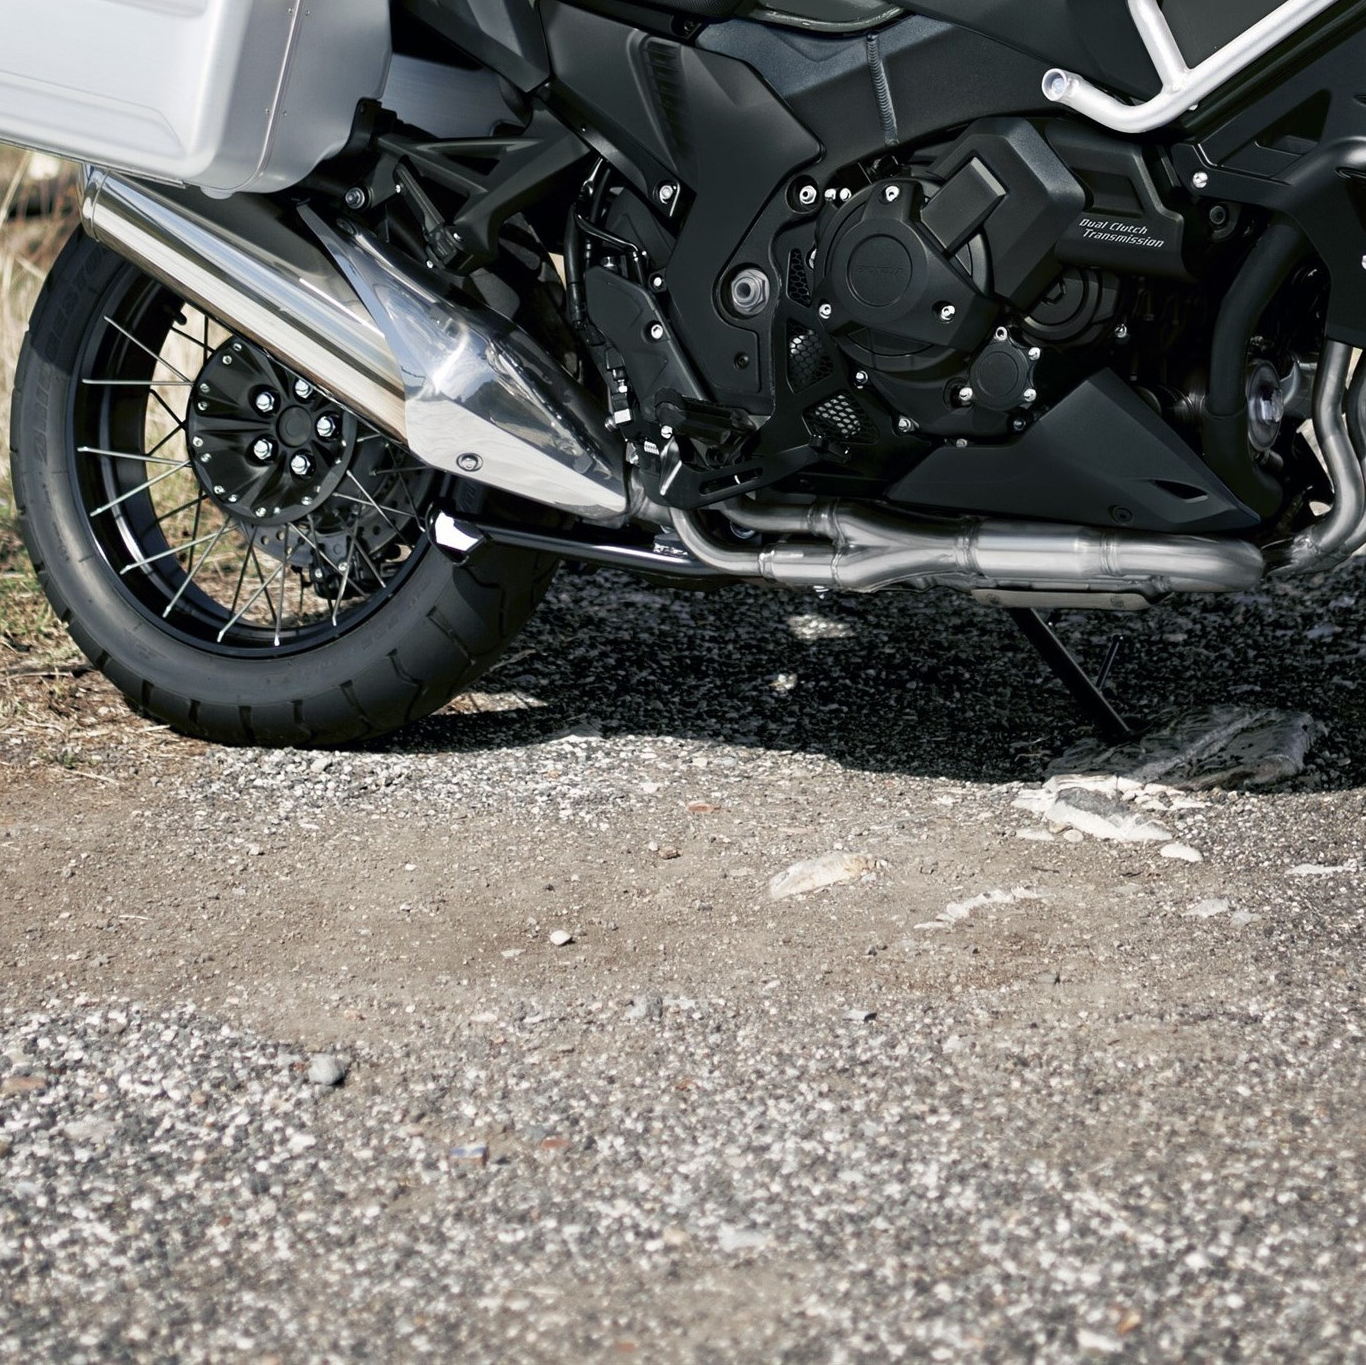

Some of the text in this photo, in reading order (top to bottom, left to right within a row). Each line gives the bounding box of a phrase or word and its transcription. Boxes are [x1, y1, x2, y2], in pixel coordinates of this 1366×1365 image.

[1078, 218, 1148, 235] Dual Clutch
[1082, 228, 1165, 248] Transmission
